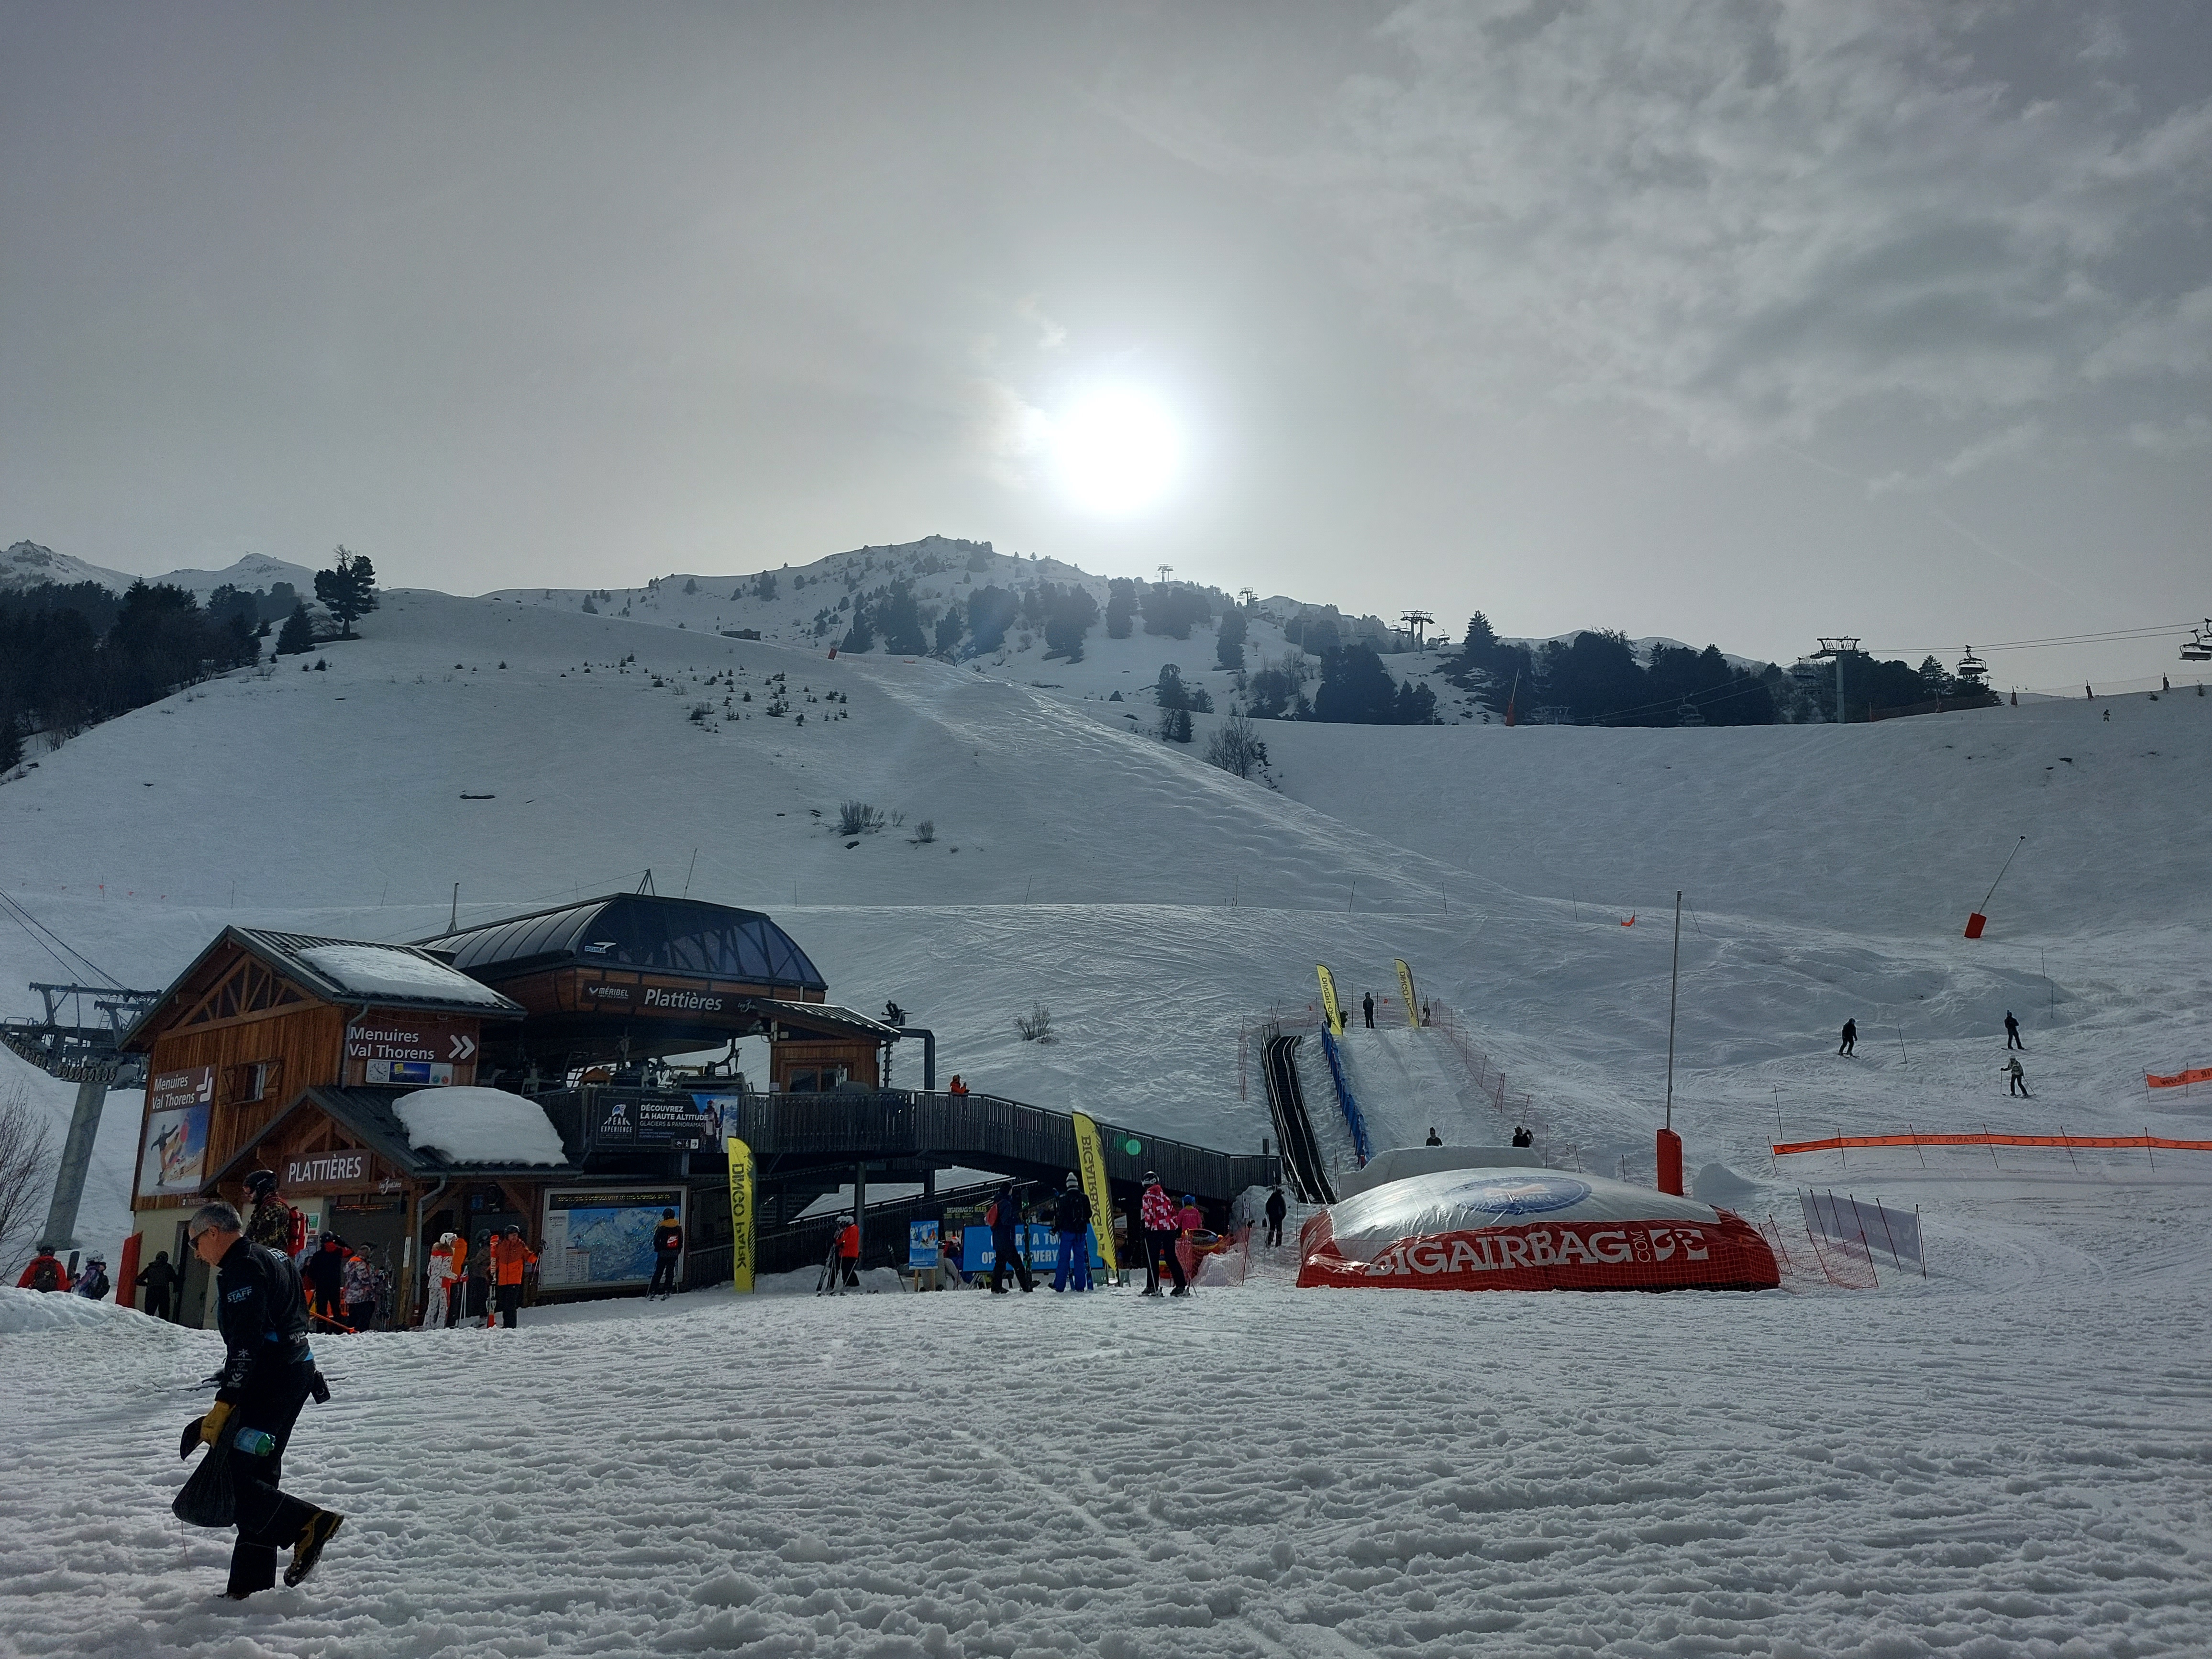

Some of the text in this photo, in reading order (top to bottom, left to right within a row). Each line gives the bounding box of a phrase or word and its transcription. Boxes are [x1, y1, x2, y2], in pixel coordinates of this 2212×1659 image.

[598, 986, 629, 996] MÉRIBEL
[644, 988, 722, 1011] Plattières
[350, 1027, 419, 1042] Menuires
[349, 1043, 434, 1060] Val Thorens
[154, 1074, 188, 1092] Menuires
[152, 1093, 195, 1109] Val Thorens
[641, 1103, 684, 1112] DÉCOUVREZ
[608, 1117, 627, 1125] PEAK
[288, 1153, 361, 1183] PLATTIÈRES
[1365, 1230, 1634, 1276] BIGAIRBAG
[227, 1289, 253, 1303] STAFF
